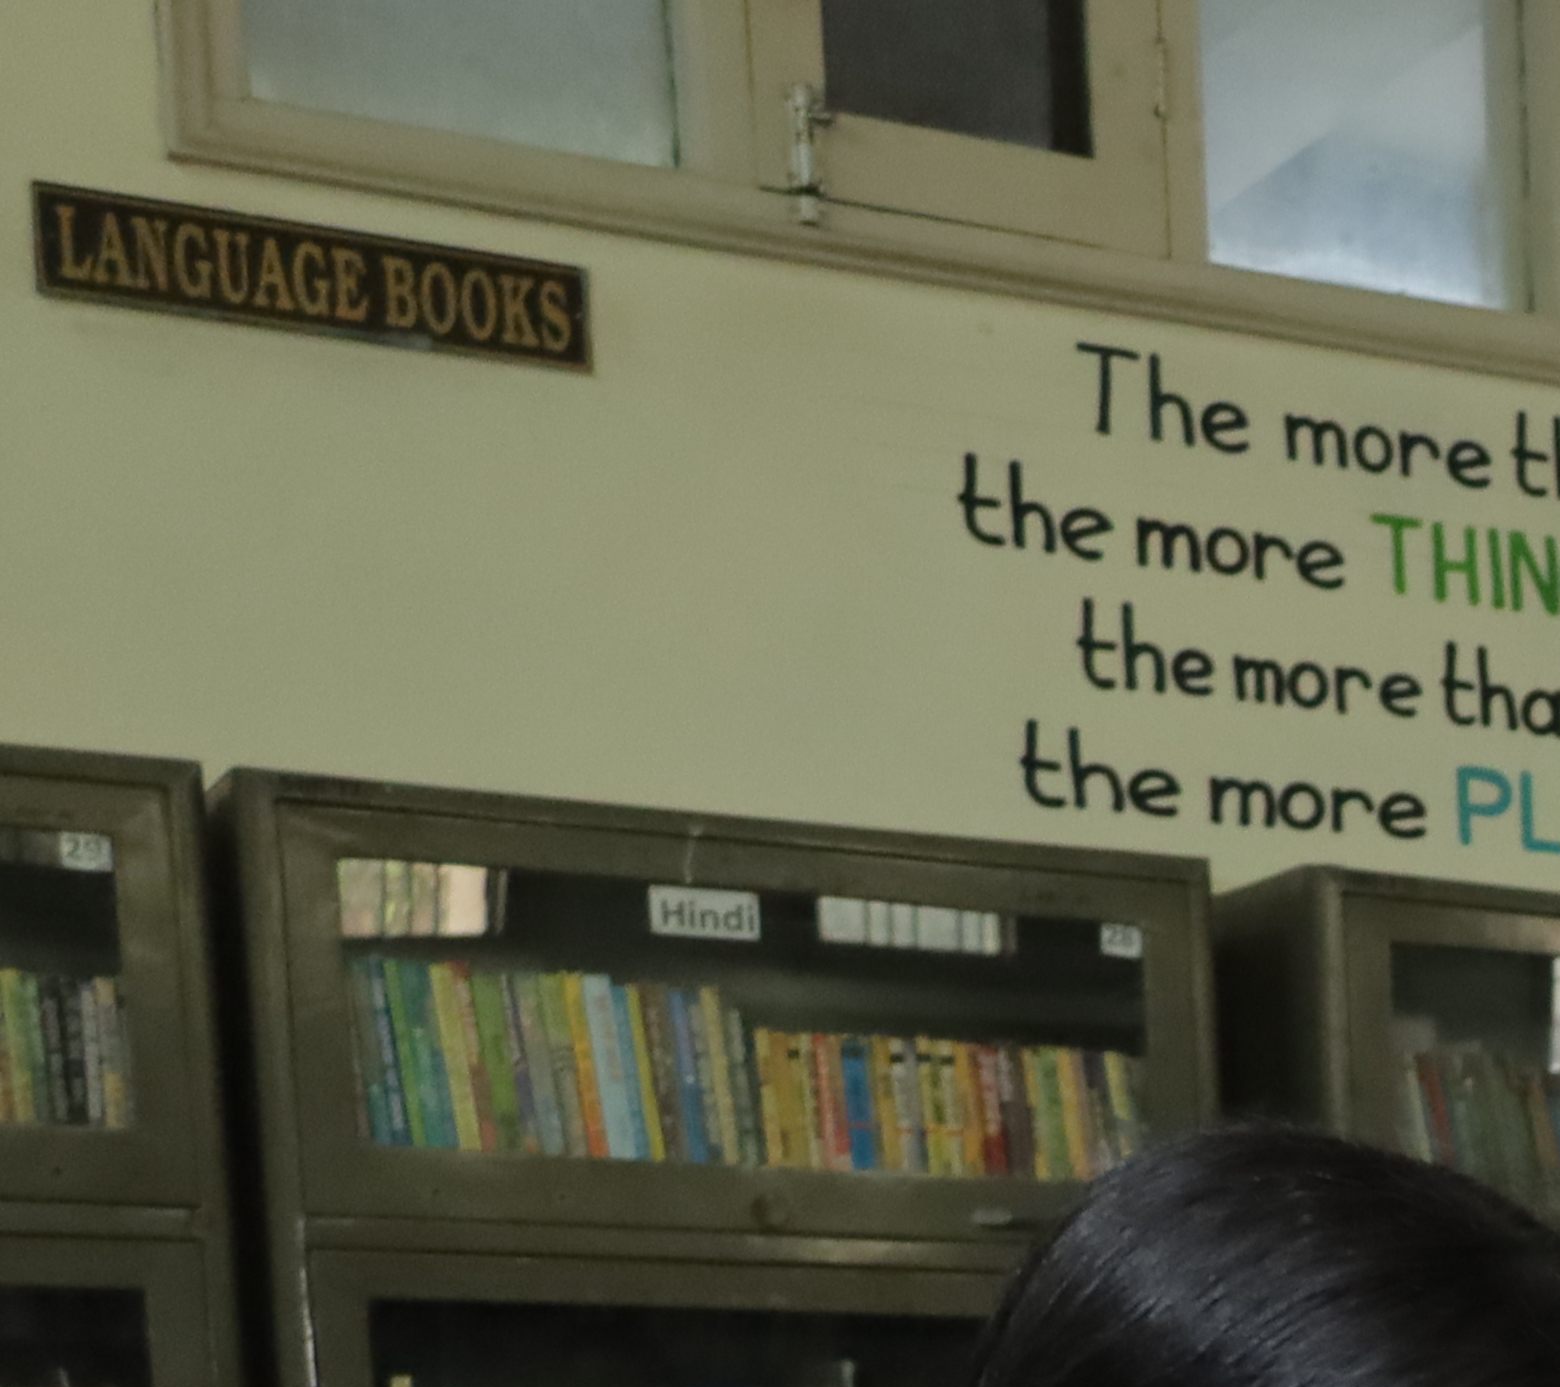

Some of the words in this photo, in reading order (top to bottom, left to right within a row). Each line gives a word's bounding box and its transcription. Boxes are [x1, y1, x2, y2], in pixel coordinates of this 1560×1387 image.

[58, 204, 369, 322] LANGUAGE
[382, 253, 573, 355] BOOKS
[1077, 343, 1251, 455] The
[1284, 412, 1492, 490] more
[957, 451, 1115, 562] the
[1135, 514, 1346, 590] more
[1075, 596, 1215, 698] the
[1231, 652, 1424, 718] more
[1019, 718, 1182, 819] the
[1208, 774, 1428, 841] more
[660, 898, 756, 934] Hindi
